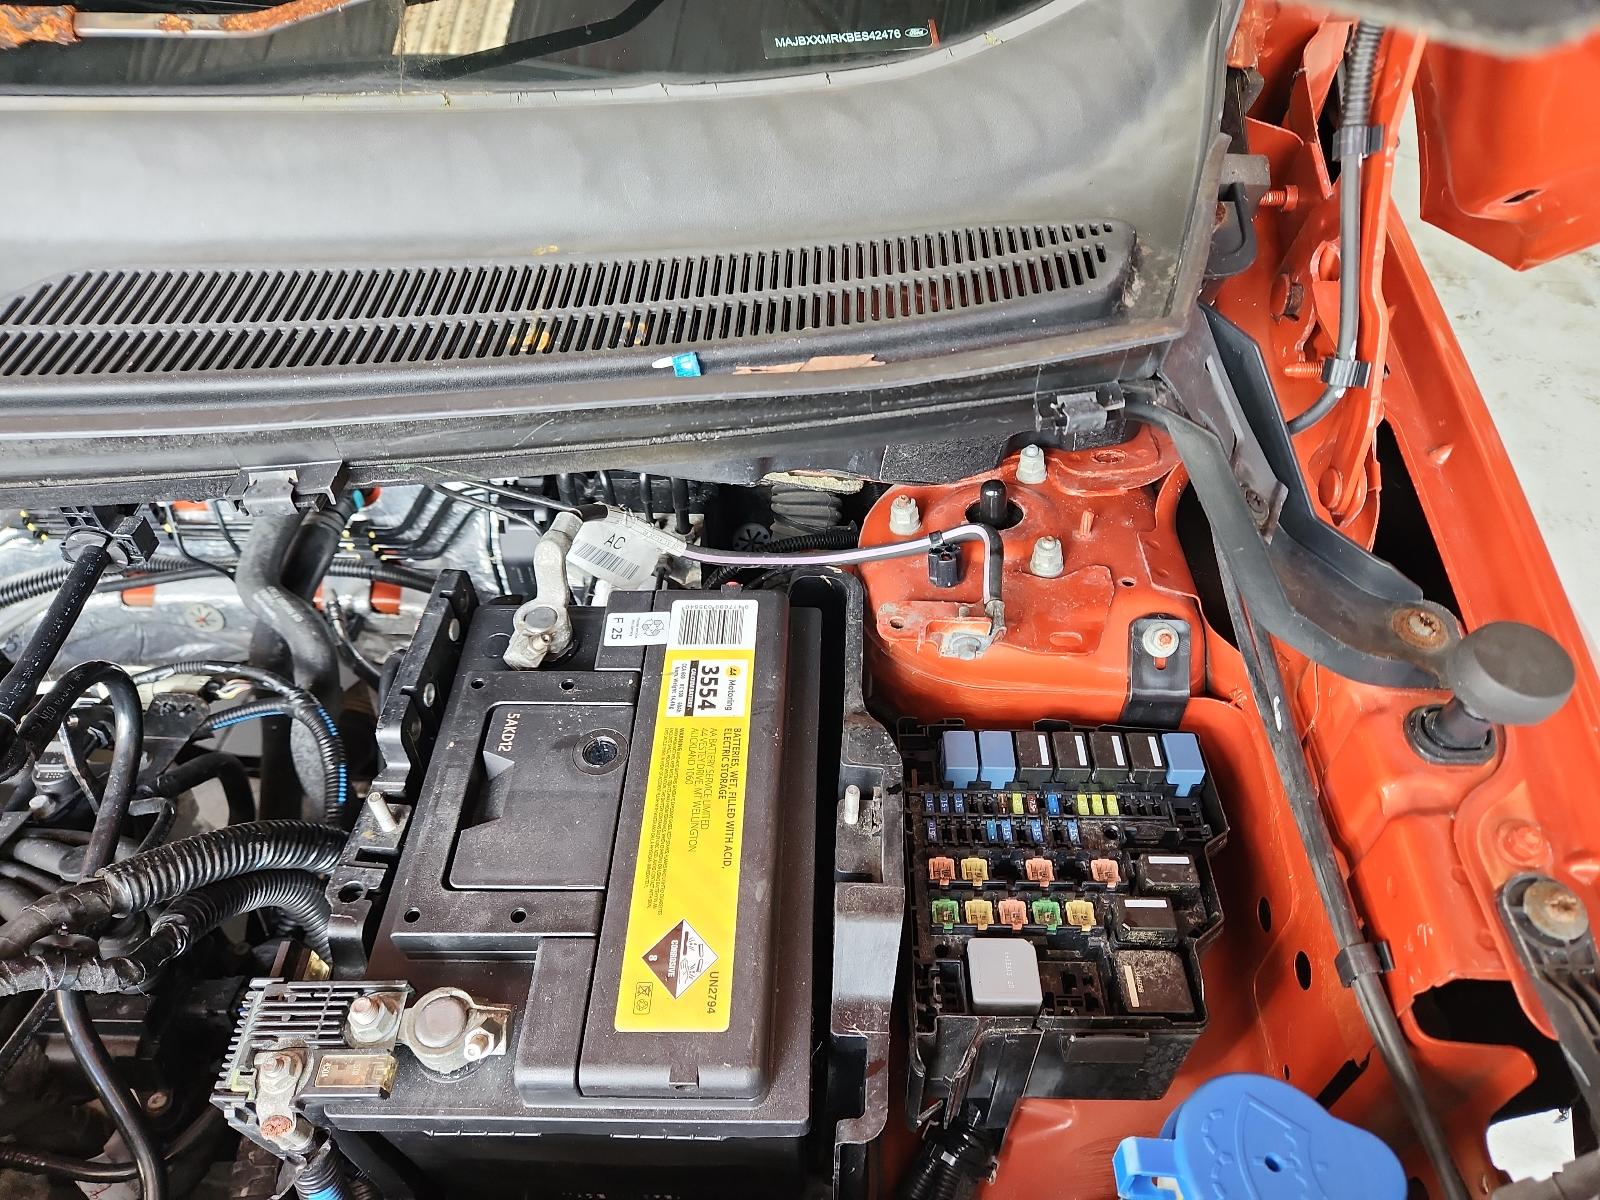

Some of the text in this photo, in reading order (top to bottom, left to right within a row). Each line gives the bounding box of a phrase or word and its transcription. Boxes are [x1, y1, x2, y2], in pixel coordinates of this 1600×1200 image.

[775, 30, 902, 48] MAJBXXMRKBES42476
[604, 533, 626, 550] AC
[612, 628, 622, 640] 25
[698, 665, 719, 710] 3554
[725, 680, 736, 710] Motoring
[498, 713, 521, 752] 5AKD12
[697, 738, 708, 763] VESTEY
[685, 728, 699, 785] AUCKLAND 1060
[694, 764, 705, 787] DRIVE,
[718, 728, 732, 800] ELECTRIC STORAGE
[693, 788, 703, 799] MT
[701, 728, 717, 830] AA BATTERY SERVICE LIMITED
[722, 728, 742, 869] BATTERIES, WET, FILLED WITH ACID,
[688, 801, 701, 853] WELLINGTON
[667, 940, 678, 978] CORROSIVE
[706, 971, 720, 1014] UN2794
